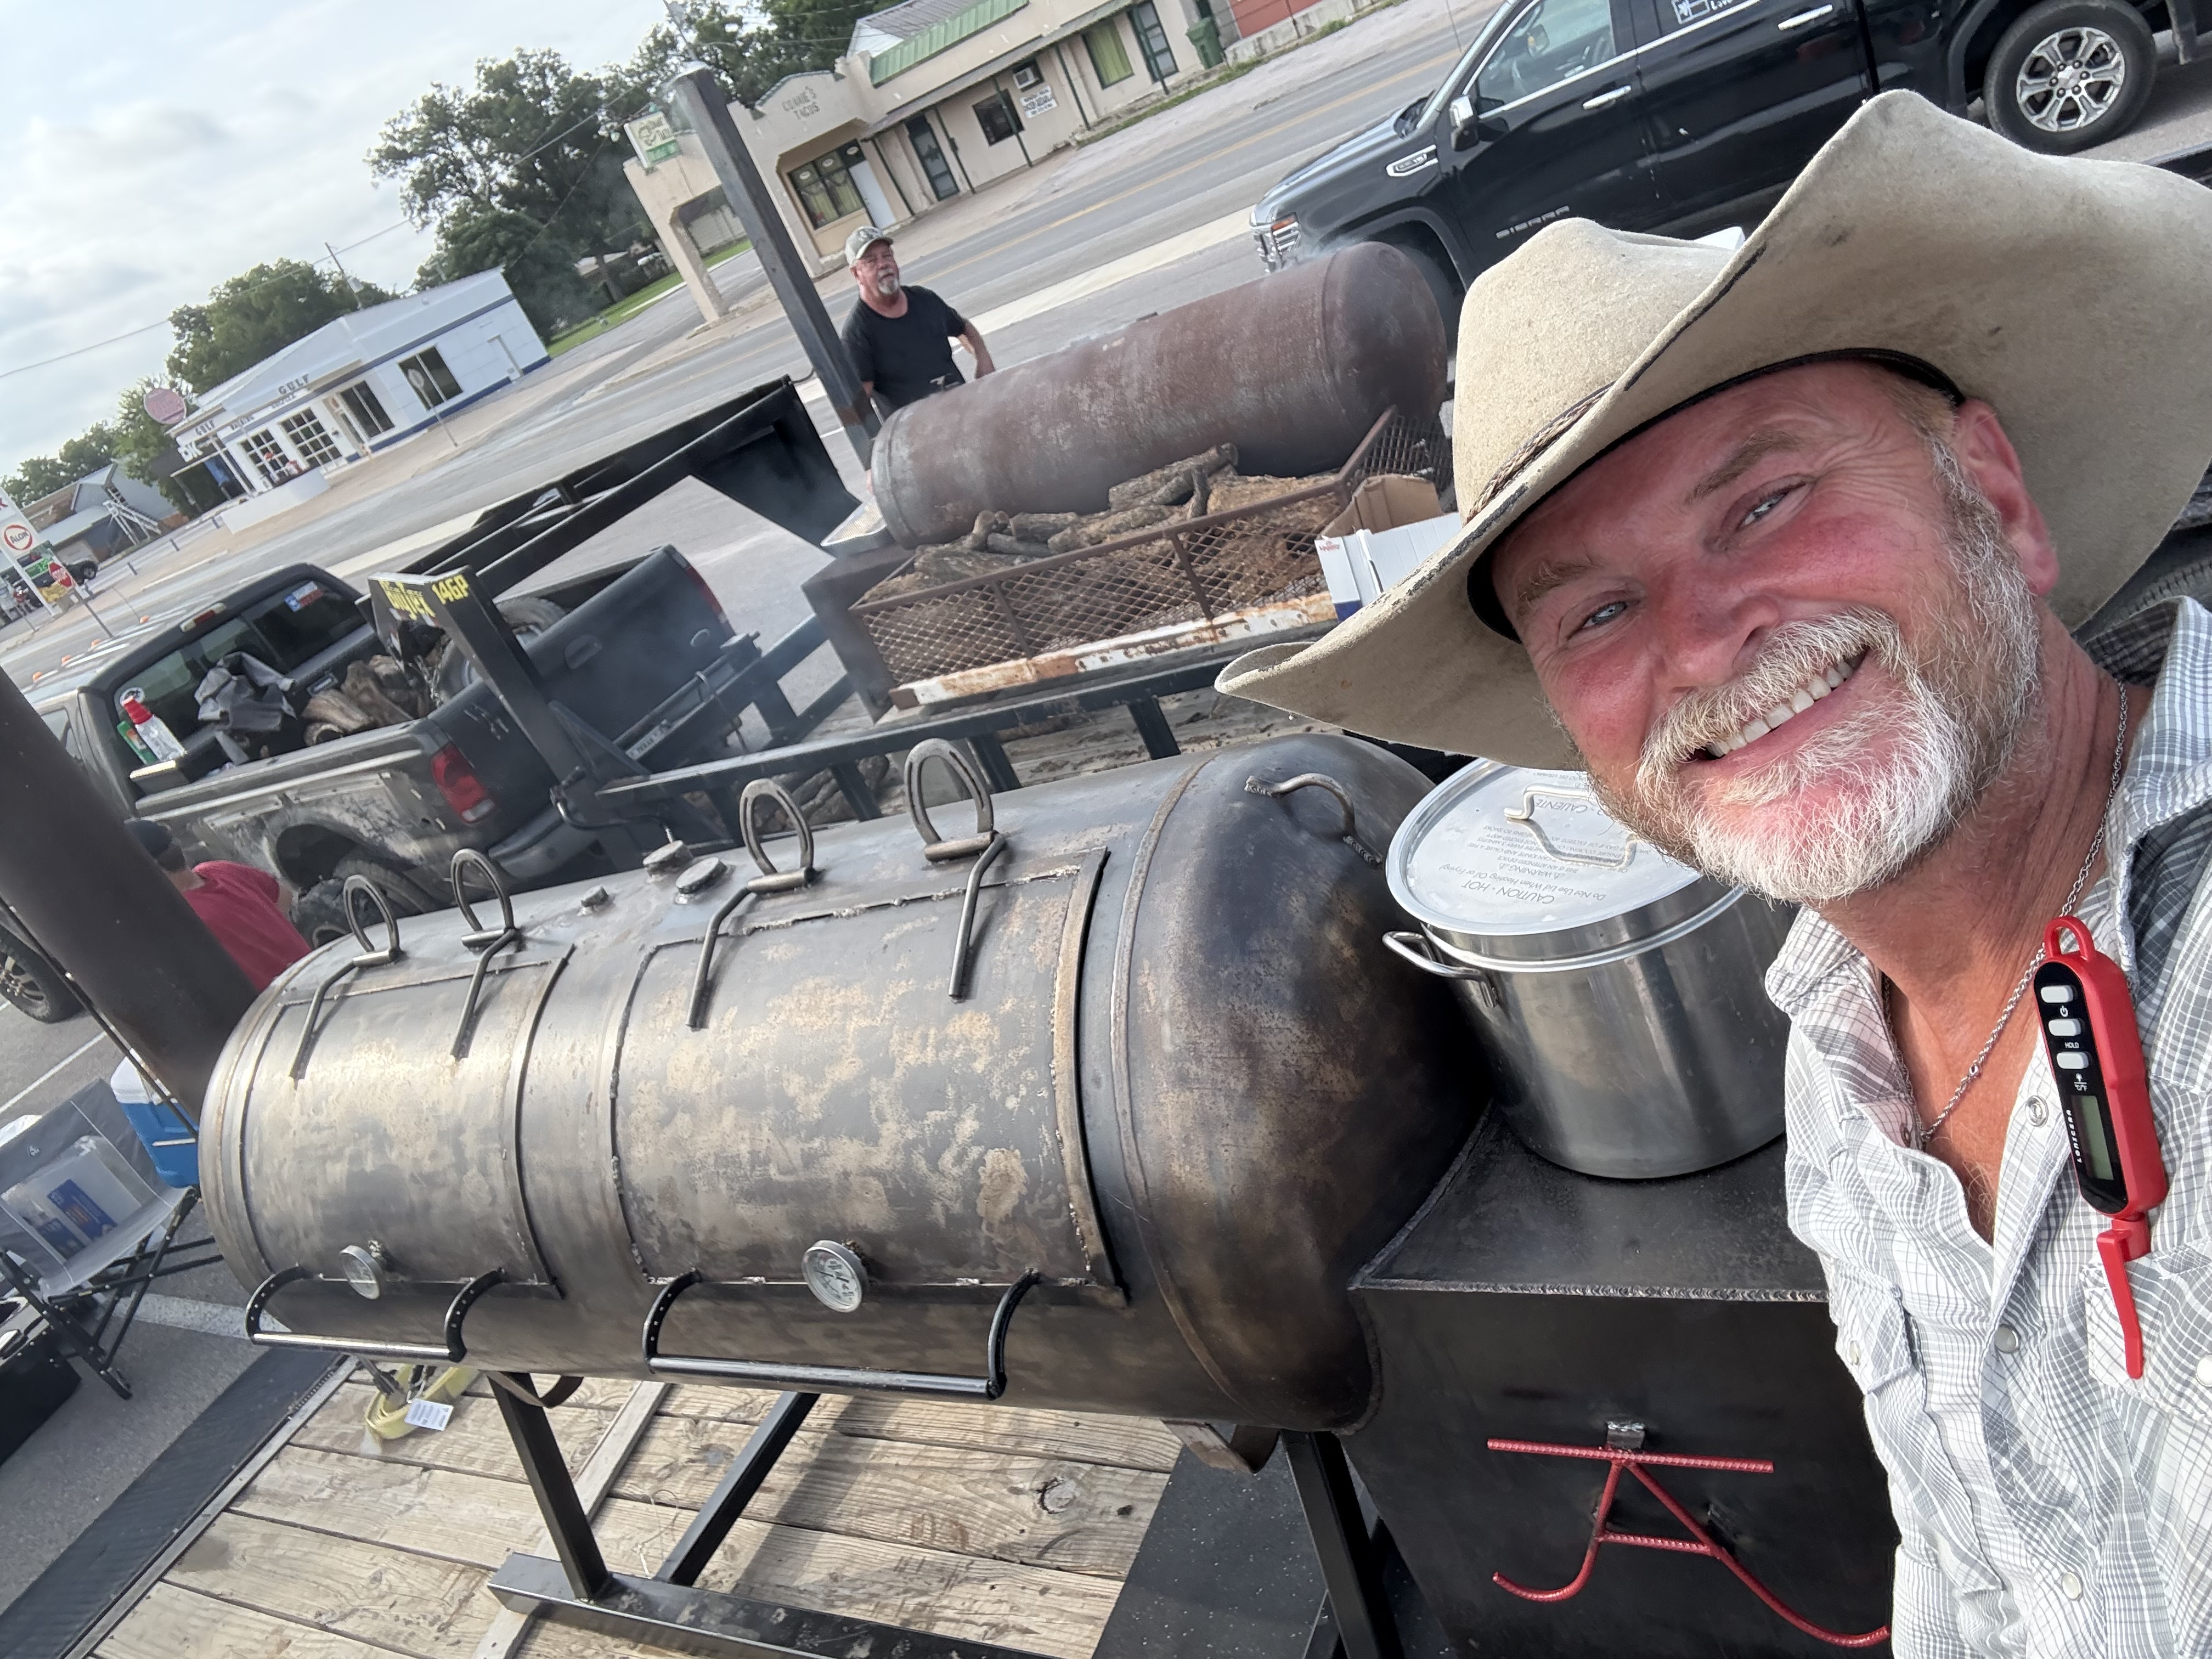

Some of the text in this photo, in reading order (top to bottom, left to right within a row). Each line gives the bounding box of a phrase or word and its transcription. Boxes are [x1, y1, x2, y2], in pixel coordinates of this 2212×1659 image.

[793, 101, 821, 120] TACOS
[1497, 205, 1570, 239] SIERRA
[278, 373, 309, 394] GULF
[195, 420, 216, 436] GULF
[10, 531, 29, 544] ALON
[52, 567, 66, 583] STOP
[1536, 798, 1588, 814] CALIENTE
[1438, 863, 1466, 874] Frying!
[1508, 865, 1552, 878] WARNING
[1474, 871, 1488, 880] Oil
[1489, 872, 1518, 885] Heating
[1520, 878, 1543, 891] When
[1543, 883, 1558, 892] Lid
[1558, 887, 1573, 895] Use
[1462, 879, 1555, 904] CAUTION HOT
[1577, 889, 1591, 898] Not
[1593, 893, 1606, 901] Do
[2066, 1109, 2083, 1164] LONICERA
